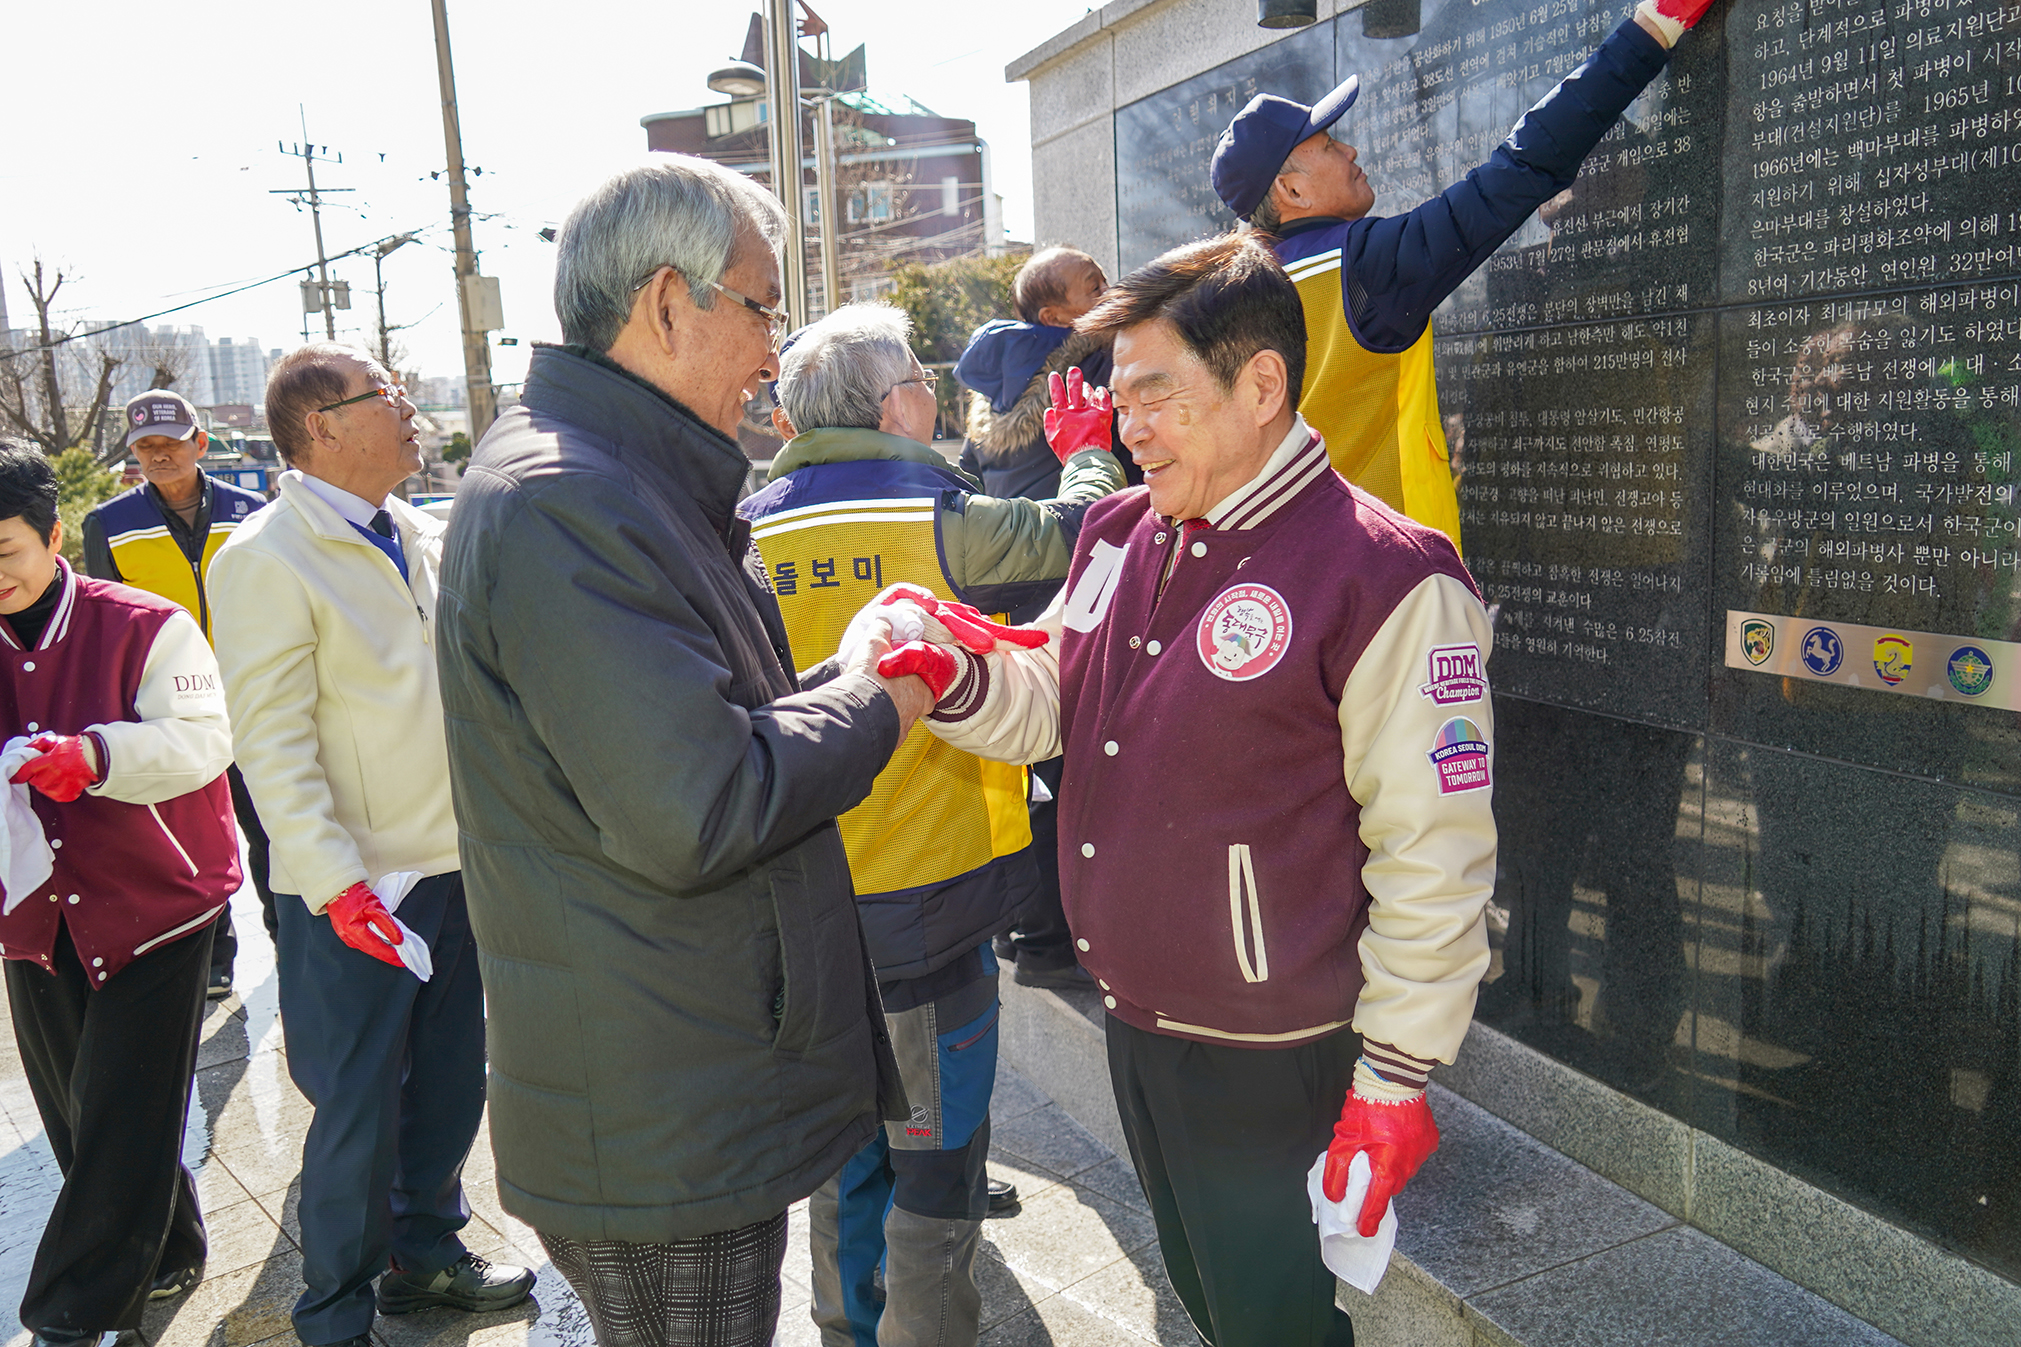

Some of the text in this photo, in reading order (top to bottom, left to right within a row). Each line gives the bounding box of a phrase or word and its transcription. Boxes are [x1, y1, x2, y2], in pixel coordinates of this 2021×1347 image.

[1466, 27, 1486, 48] 위해
[1490, 13, 1525, 40] 1950년
[1530, 3, 1548, 24] 6월
[1755, 4, 1803, 31] 요청을
[1422, 66, 1453, 88] 38도선
[1523, 24, 1568, 54] 기습적인
[1576, 10, 1612, 37] 남침을
[1755, 9, 1886, 60] 하고, 단계적으로
[1761, 37, 1895, 90] 1964년 9월 11일
[1678, 74, 1691, 94] 반
[1753, 98, 1783, 122] 항을
[1791, 73, 1876, 112] 출발하면서
[1888, 67, 1903, 91] 첫
[1913, 50, 1970, 81] 파병이
[1635, 107, 1691, 134] 26일에는
[1752, 80, 1988, 151] 부대(건설지원단)를 1965년
[1617, 136, 1691, 167] 개입으로 38
[1752, 125, 1939, 178] 1966년에는 백마부대를
[1751, 172, 1860, 208] 지원하기 위해
[1593, 204, 1641, 227] 부근에서
[1650, 194, 1690, 219] 장기간
[1751, 192, 1934, 239] 은마부대를 창설하였다.
[1582, 232, 1642, 259] 판문점에서
[1649, 224, 1688, 247] 휴전협
[1754, 213, 1998, 267] 한국군은 파리평화조약에 의해
[1748, 255, 1935, 295] 8년여 기간동안 연인원
[1748, 285, 2019, 329] 최초이자 최대규모의 해외파병이
[1540, 332, 1562, 348] 하고
[1622, 323, 1645, 340] 해도
[1747, 338, 1776, 359] 들이
[1783, 334, 1831, 355] 소중한
[1840, 329, 1891, 351] 목숨을
[1901, 325, 1955, 349] 잃기도
[1594, 350, 1653, 370] 215만명의
[1662, 347, 1687, 366] 전사
[1752, 365, 1814, 386] 한국군은
[1823, 361, 1873, 383] 베트남
[1882, 356, 1954, 380] 전쟁에서
[1746, 385, 2019, 415] 현지 주민에 대한 지원활동을 통해
[1634, 406, 1684, 424] 민간항공
[1646, 435, 1684, 452] 연평도
[1829, 422, 1923, 441] 수행하였다.
[1653, 463, 1682, 480] 있다.
[1752, 451, 2010, 473] 대한민국은 베트남 파병을 통해
[1615, 489, 1665, 508] 전쟁고아
[1670, 491, 1683, 509] 등
[1744, 481, 2013, 505] 현대화를 이루었으며, 국가발전의
[1535, 512, 1557, 529] 않고
[1562, 513, 1595, 531] 끝나지
[1602, 516, 1626, 533] 않은
[1631, 517, 1681, 536] 전쟁으로
[1743, 509, 2021, 538] 자유우방군의 일원으로서 한국군이
[1741, 536, 2021, 571] 은 해외파병사 뿐만 아니라
[773, 555, 882, 596] 돌보미
[1589, 569, 1624, 587] 전쟁은
[1741, 563, 1940, 597] 기록임에 틀림없을 것이다.
[1437, 655, 1476, 680] DDM
[172, 675, 215, 692] DDM
[1437, 685, 1479, 700] Champion
[1435, 745, 1457, 760] KOREA
[1458, 744, 1475, 752] SEOUL
[1442, 757, 1485, 774] GATEWAY TO
[1446, 769, 1486, 786] TOMORROW
[906, 1128, 932, 1136] PEAK
